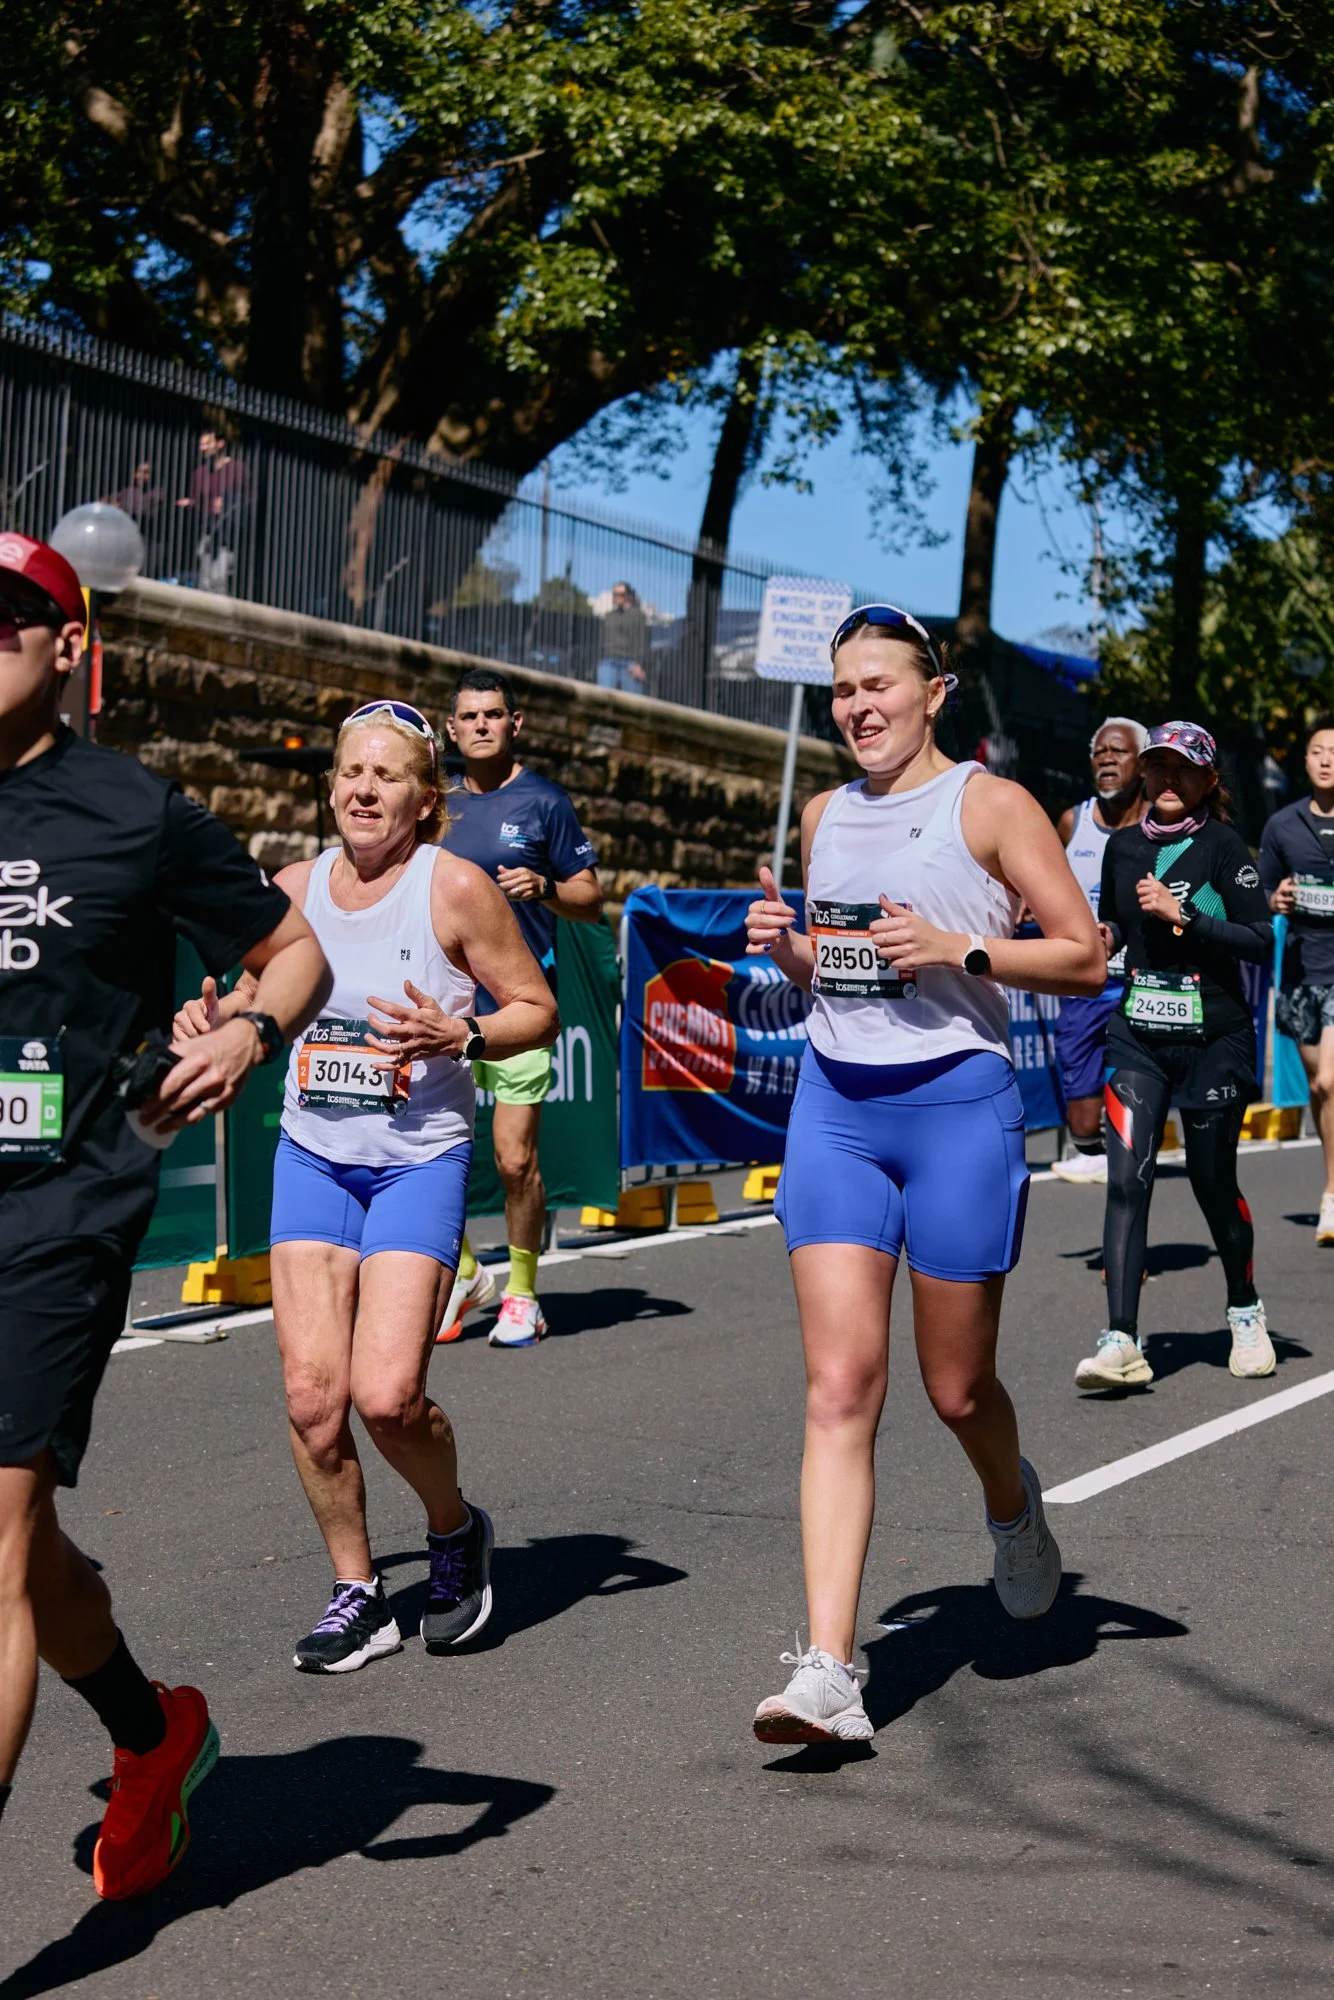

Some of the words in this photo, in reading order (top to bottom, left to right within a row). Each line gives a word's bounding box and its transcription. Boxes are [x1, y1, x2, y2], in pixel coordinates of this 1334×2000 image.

[771, 595, 816, 608] SWITCH
[821, 600, 843, 611] OFF
[772, 611, 816, 624] ENGINE
[823, 615, 839, 627] TO
[782, 644, 819, 657] NOISE
[0, 928, 40, 970] b
[1136, 998, 1188, 1017] 24256
[650, 1000, 730, 1048] CHEMIST
[311, 1028, 330, 1041] tcs
[18, 1059, 51, 1071] TATA
[300, 1066, 307, 1077] 2
[315, 1060, 382, 1086] 30143
[1220, 1085, 1237, 1099] T8
[0, 1097, 27, 1124] 0
[44, 1105, 56, 1120] D
